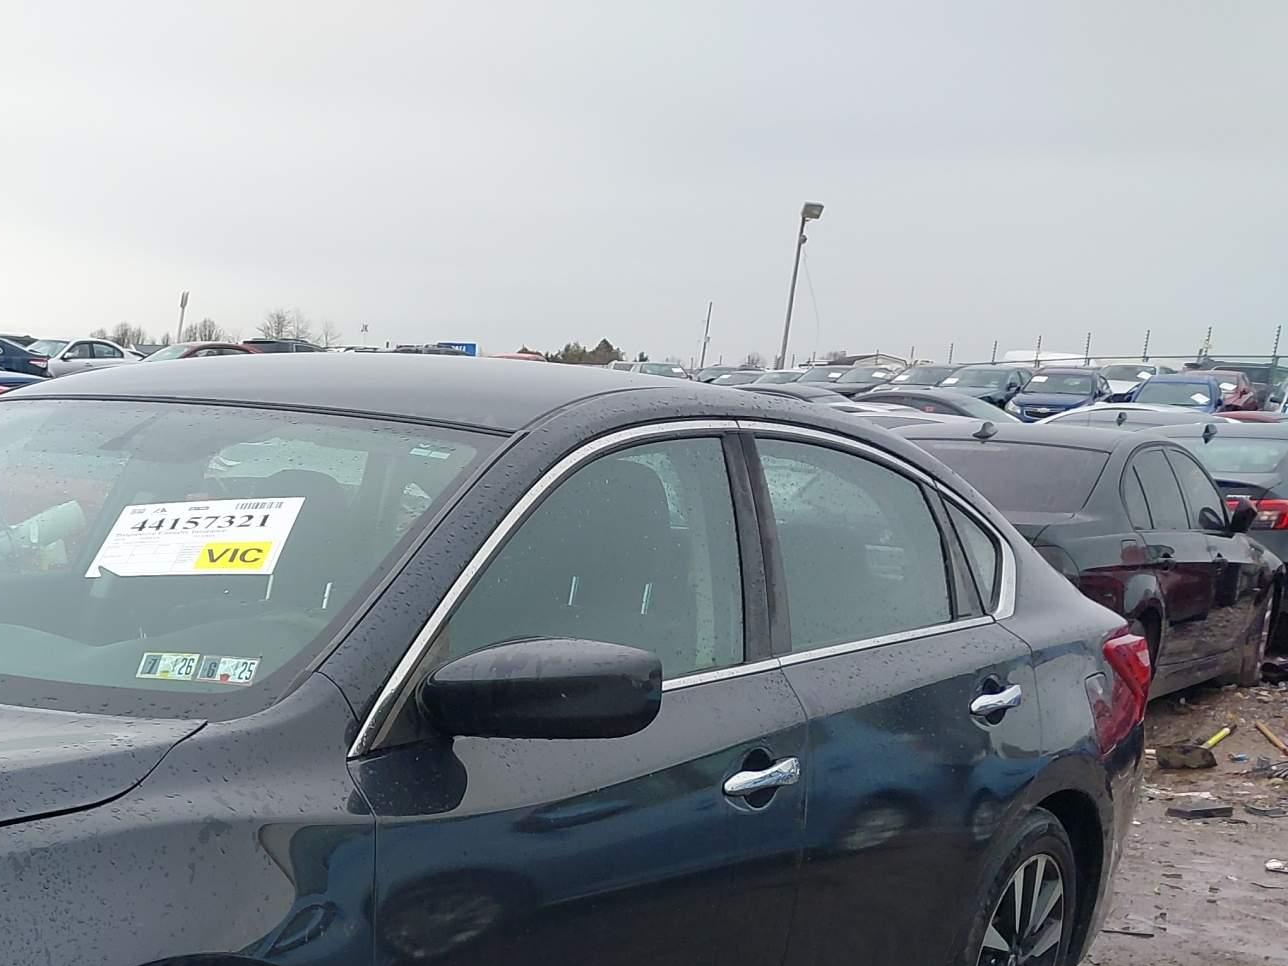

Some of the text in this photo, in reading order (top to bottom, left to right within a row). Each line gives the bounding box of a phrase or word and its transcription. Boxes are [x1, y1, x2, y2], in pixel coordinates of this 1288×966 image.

[130, 513, 271, 532] 44157321
[207, 548, 264, 564] VIC
[178, 657, 195, 676] 26
[206, 661, 255, 680] 6 25
